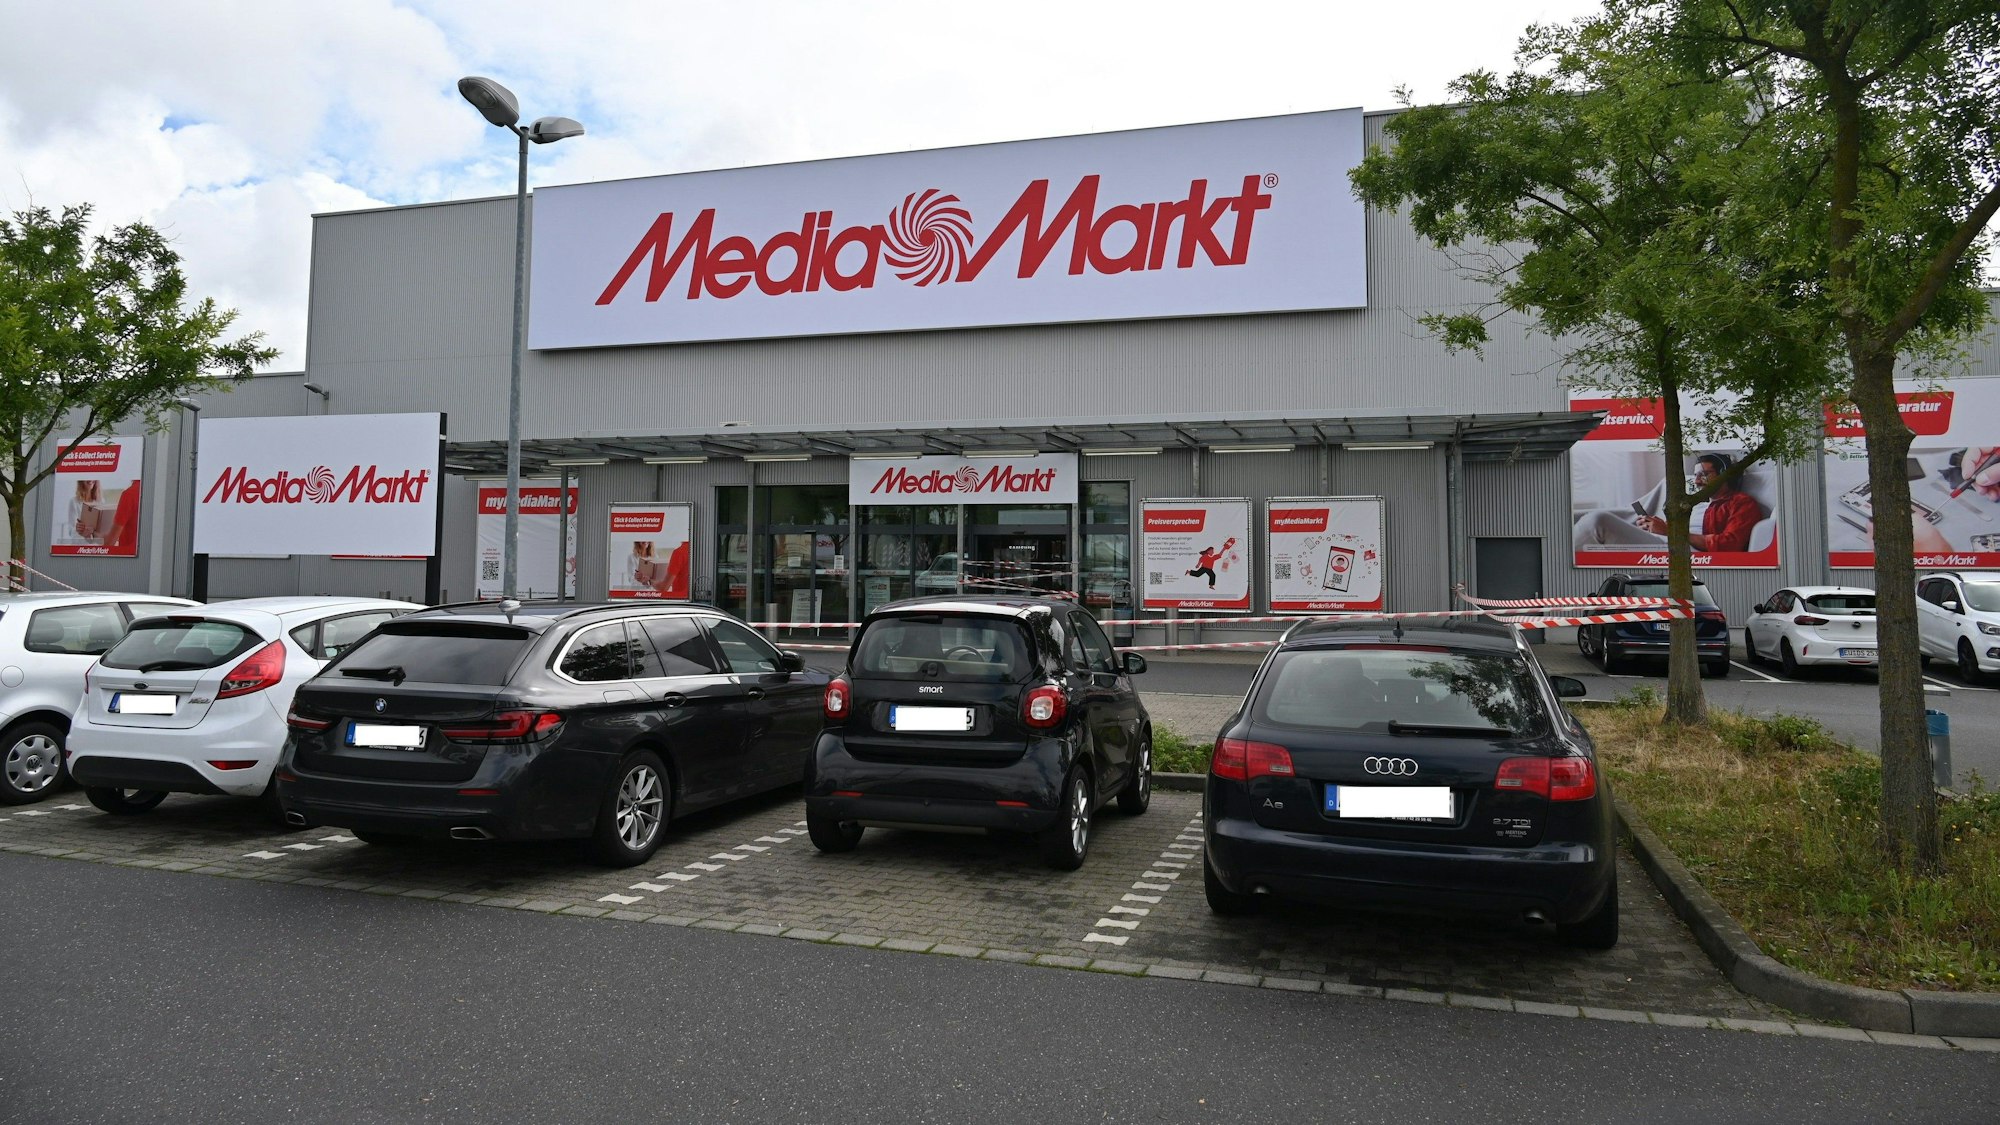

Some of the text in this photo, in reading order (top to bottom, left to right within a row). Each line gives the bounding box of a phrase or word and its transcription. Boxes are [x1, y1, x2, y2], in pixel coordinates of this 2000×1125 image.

[595, 174, 1272, 306] Media Markt
[96, 451, 116, 459] Service
[202, 464, 429, 504] Media Markt
[870, 465, 1056, 494] Media Markt
[1148, 518, 1200, 526] Preisversprechen
[1274, 517, 1323, 526] myMediaMarkt
[918, 685, 943, 694] smart
[1262, 797, 1284, 809] A6
